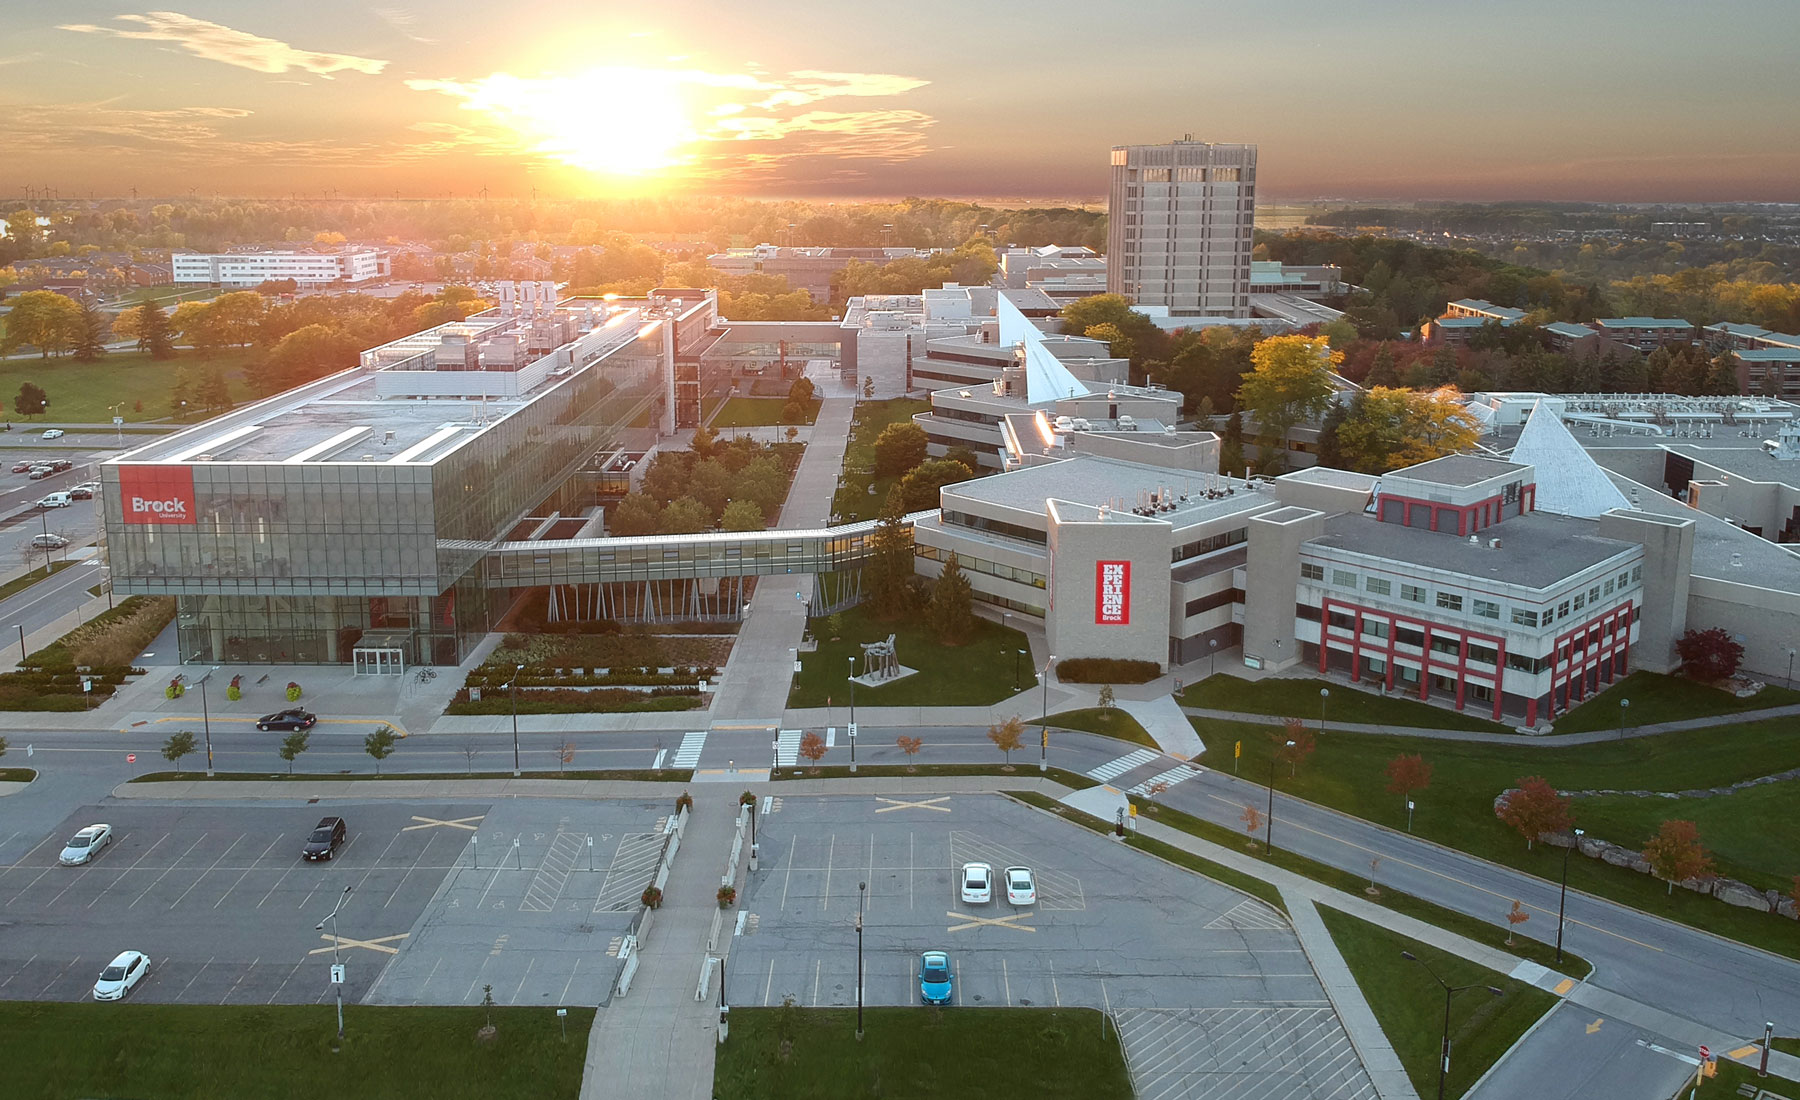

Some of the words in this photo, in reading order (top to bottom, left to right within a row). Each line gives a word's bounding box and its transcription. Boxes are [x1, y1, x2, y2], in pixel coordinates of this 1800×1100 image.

[132, 497, 186, 512] Brock
[605, 936, 623, 957] STOP
[333, 971, 339, 981] 1
